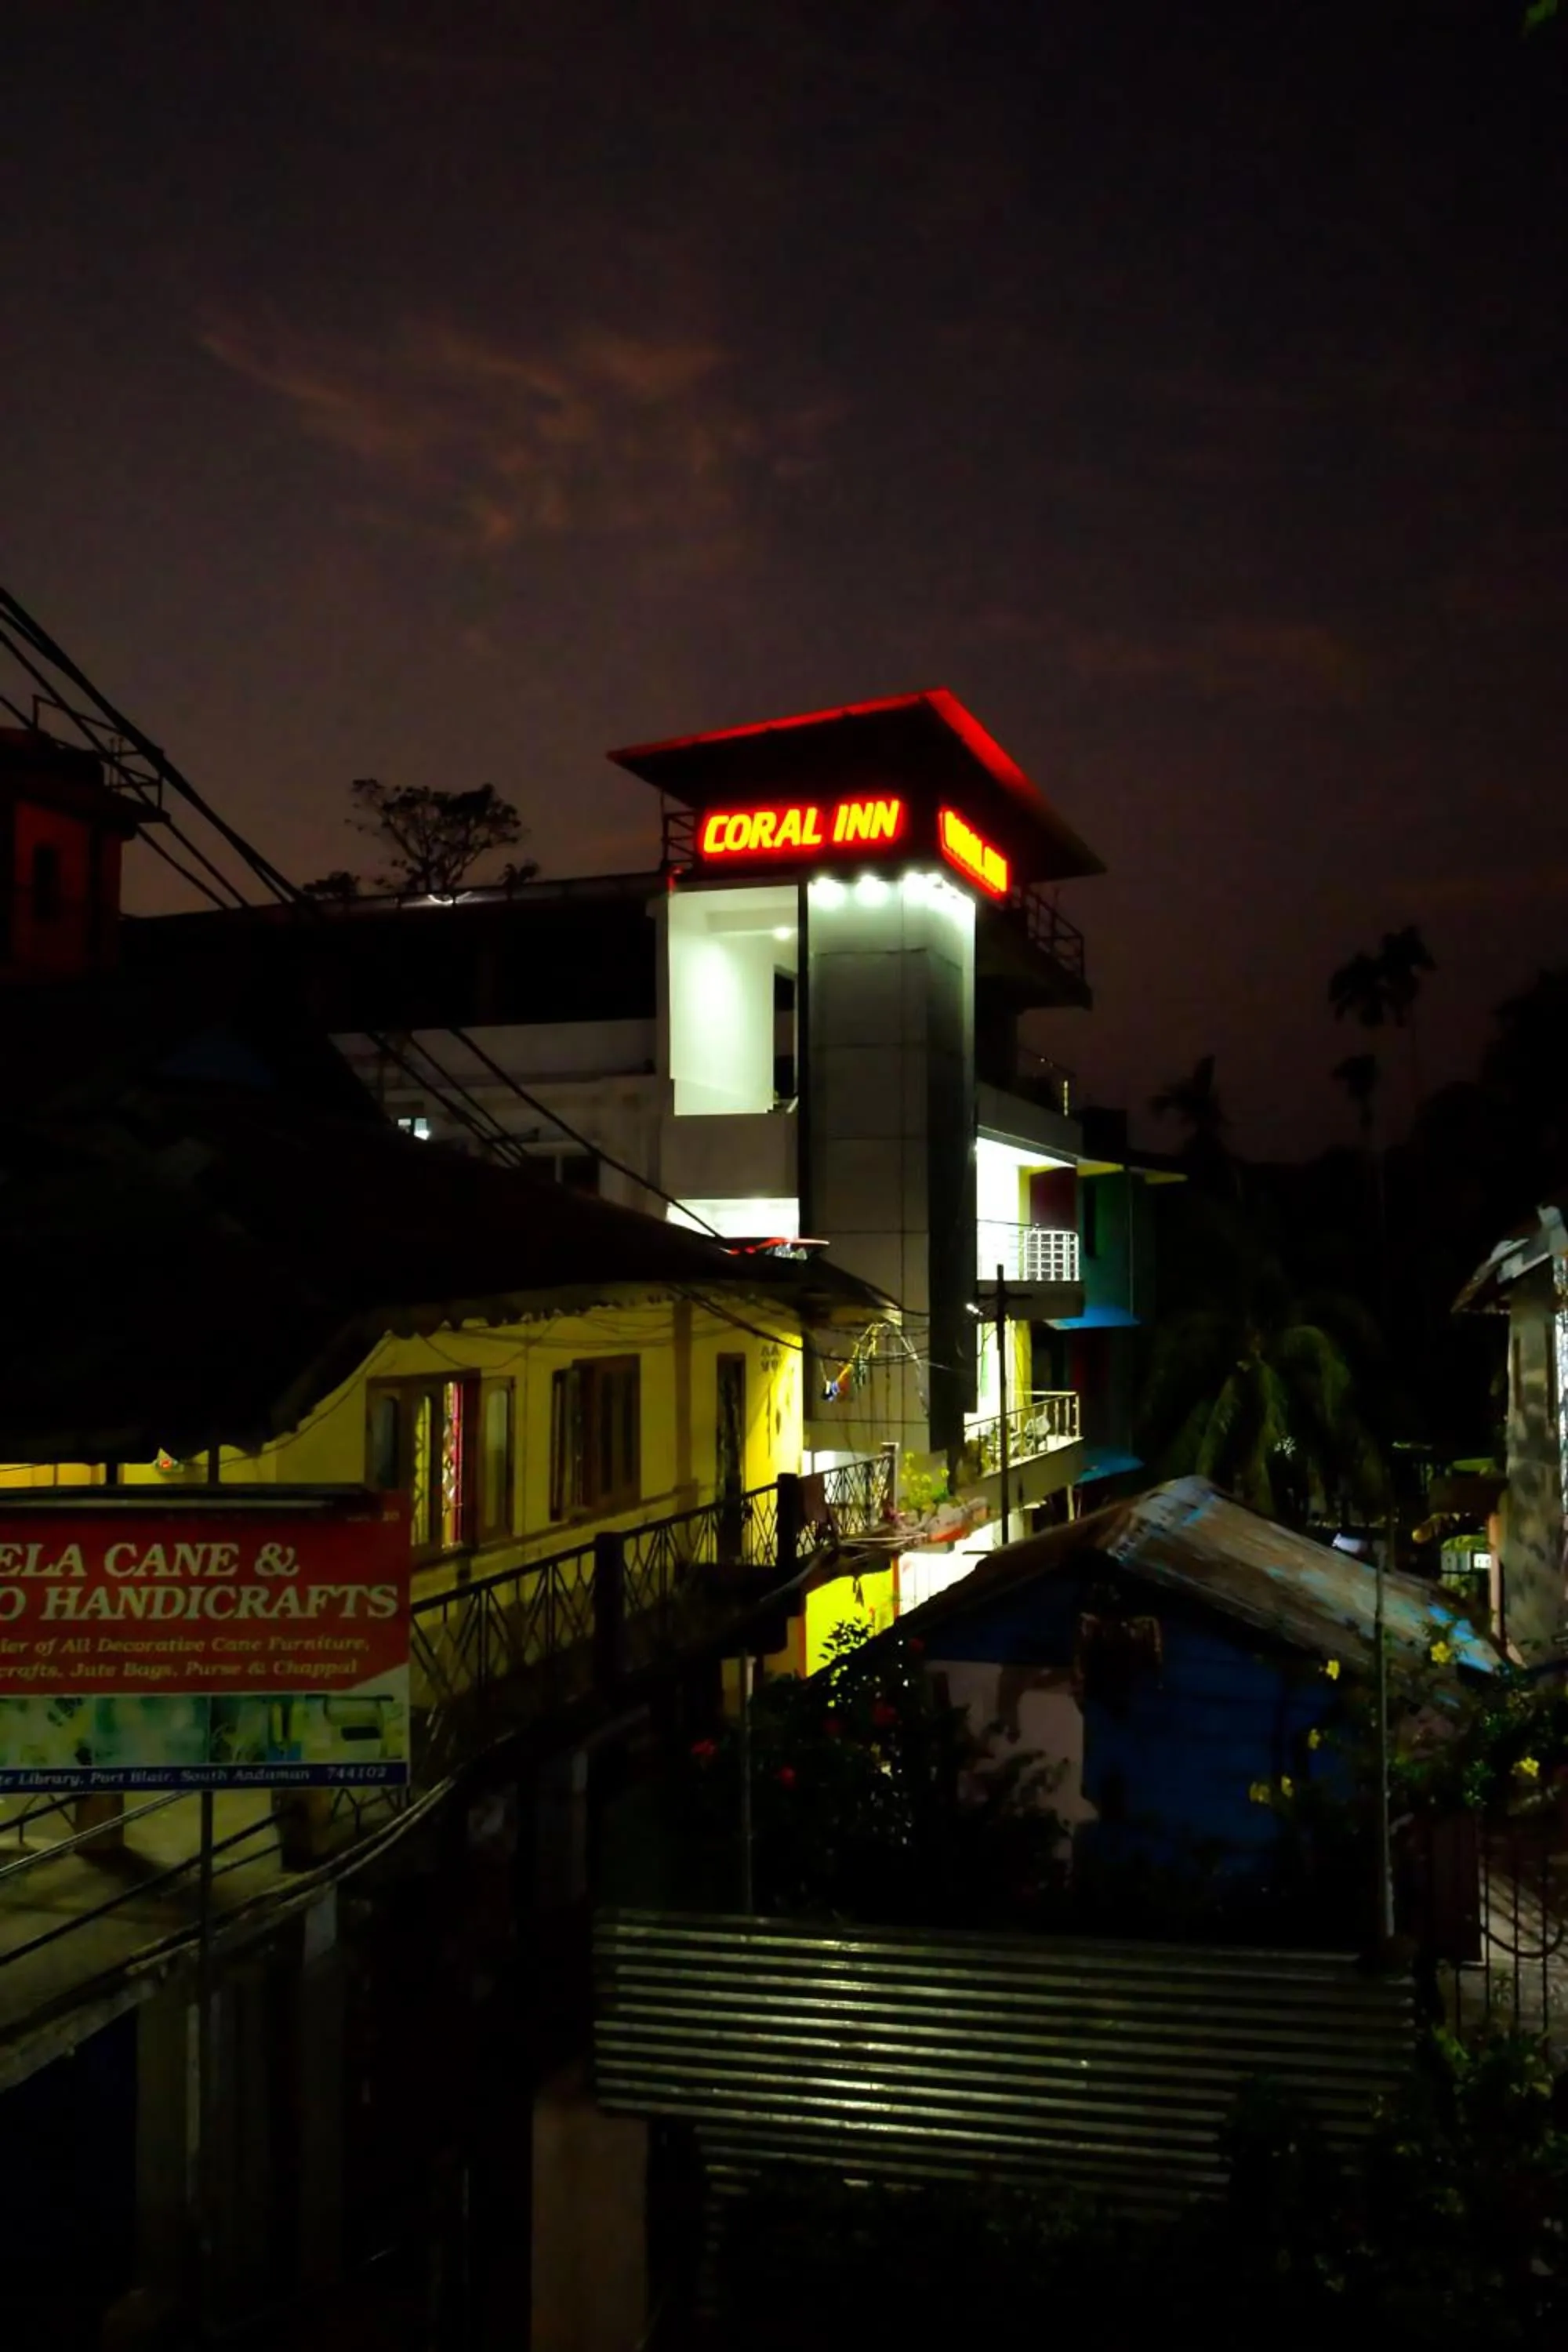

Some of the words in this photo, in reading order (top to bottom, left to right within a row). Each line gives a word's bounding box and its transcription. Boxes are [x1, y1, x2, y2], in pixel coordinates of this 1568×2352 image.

[703, 808, 822, 853] CORAL
[833, 800, 899, 843] INN
[104, 1542, 240, 1577] CANE
[254, 1542, 301, 1577] &
[39, 1584, 399, 1621] HANDICRAFTS
[34, 1637, 57, 1657] of
[60, 1636, 91, 1653] All
[97, 1635, 205, 1653] Decorative
[211, 1636, 262, 1652] Cane
[268, 1635, 370, 1652] Furniture,
[69, 1662, 118, 1678] Jute
[186, 1661, 241, 1676] Purse
[247, 1661, 267, 1675] &
[273, 1658, 358, 1679] Chappal
[90, 1770, 125, 1784] Port
[180, 1769, 227, 1782] South
[233, 1767, 310, 1781] Andaman
[326, 1766, 389, 1780] 744102
